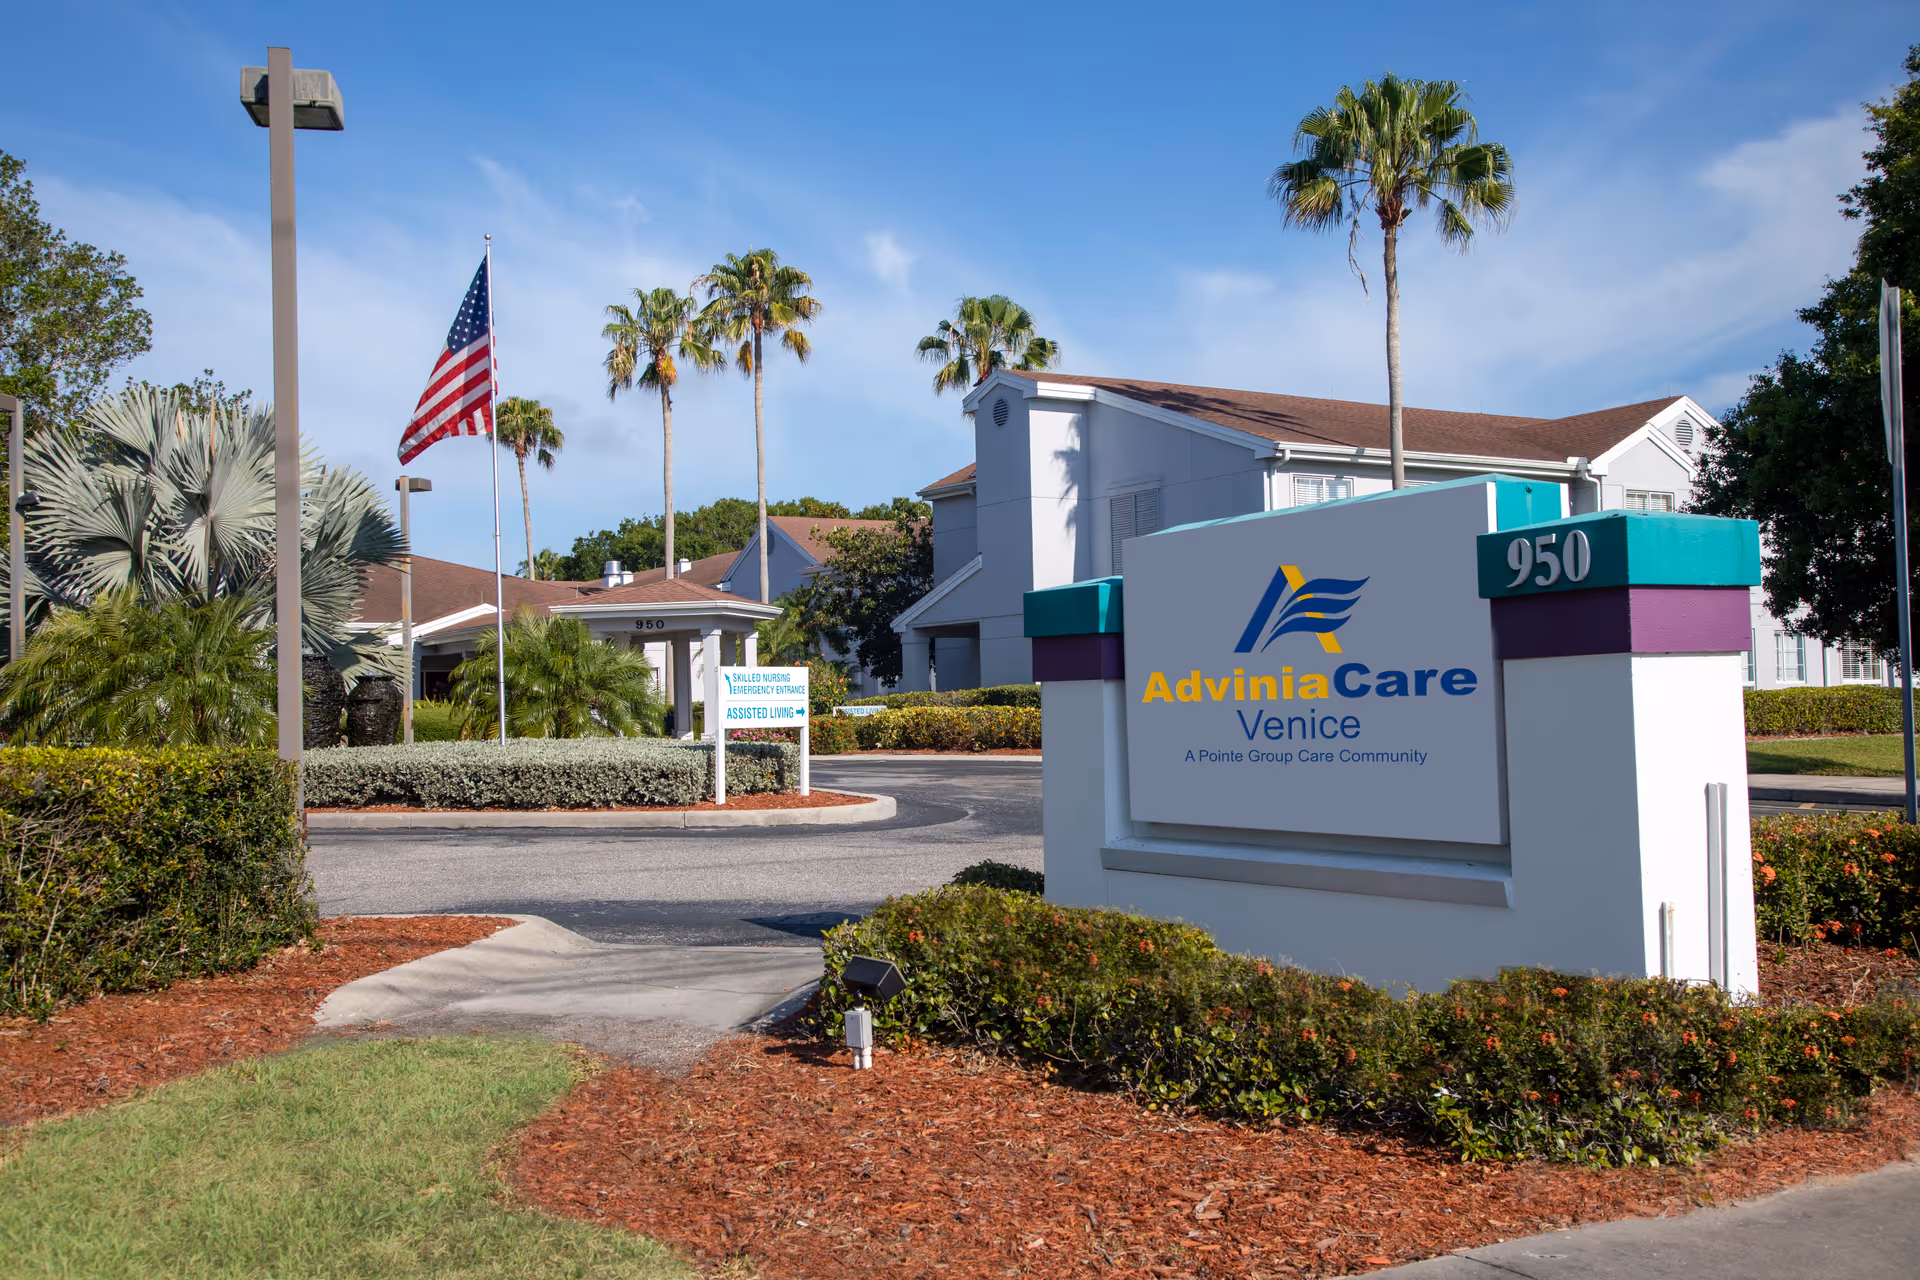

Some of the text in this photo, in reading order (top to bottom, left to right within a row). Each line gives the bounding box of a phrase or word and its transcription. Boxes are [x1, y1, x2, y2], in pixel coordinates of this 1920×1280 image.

[1506, 529, 1591, 588] 950
[635, 619, 665, 630] 950
[732, 673, 791, 682] SKILLED NURSING
[1142, 662, 1478, 703] AdviniaCare
[733, 685, 805, 695] EMERGENCY ENTRANCE
[726, 706, 794, 719] ASSISTED LIVING
[1236, 709, 1361, 740] Venice
[1184, 749, 1428, 766] A Pointe Group Care Community
